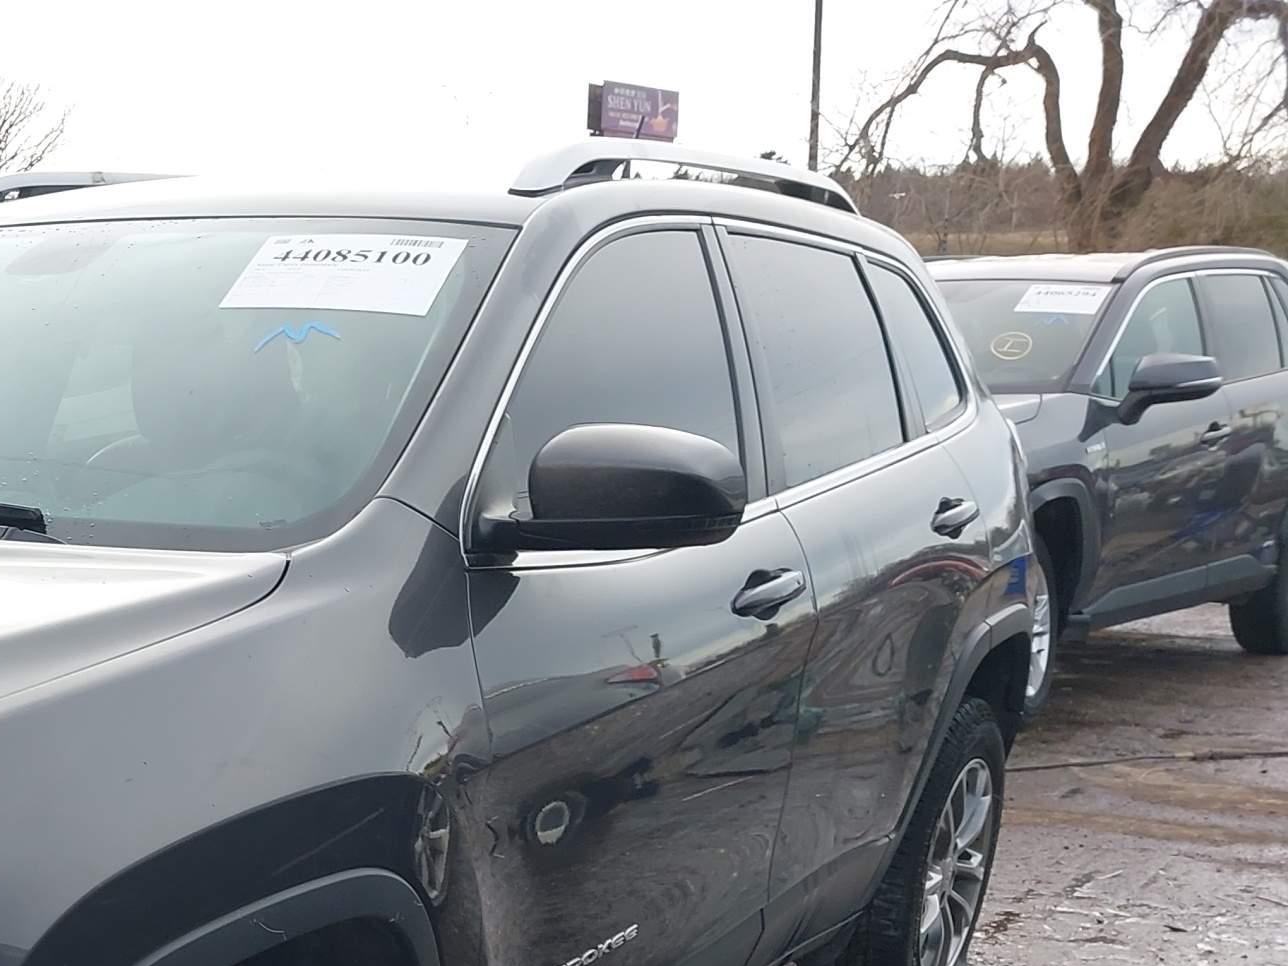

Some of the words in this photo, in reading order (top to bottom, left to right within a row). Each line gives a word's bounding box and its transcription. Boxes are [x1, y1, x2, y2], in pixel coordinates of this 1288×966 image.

[607, 95, 631, 109] SHEN
[632, 98, 651, 113] YUN
[273, 248, 432, 267] 44085100
